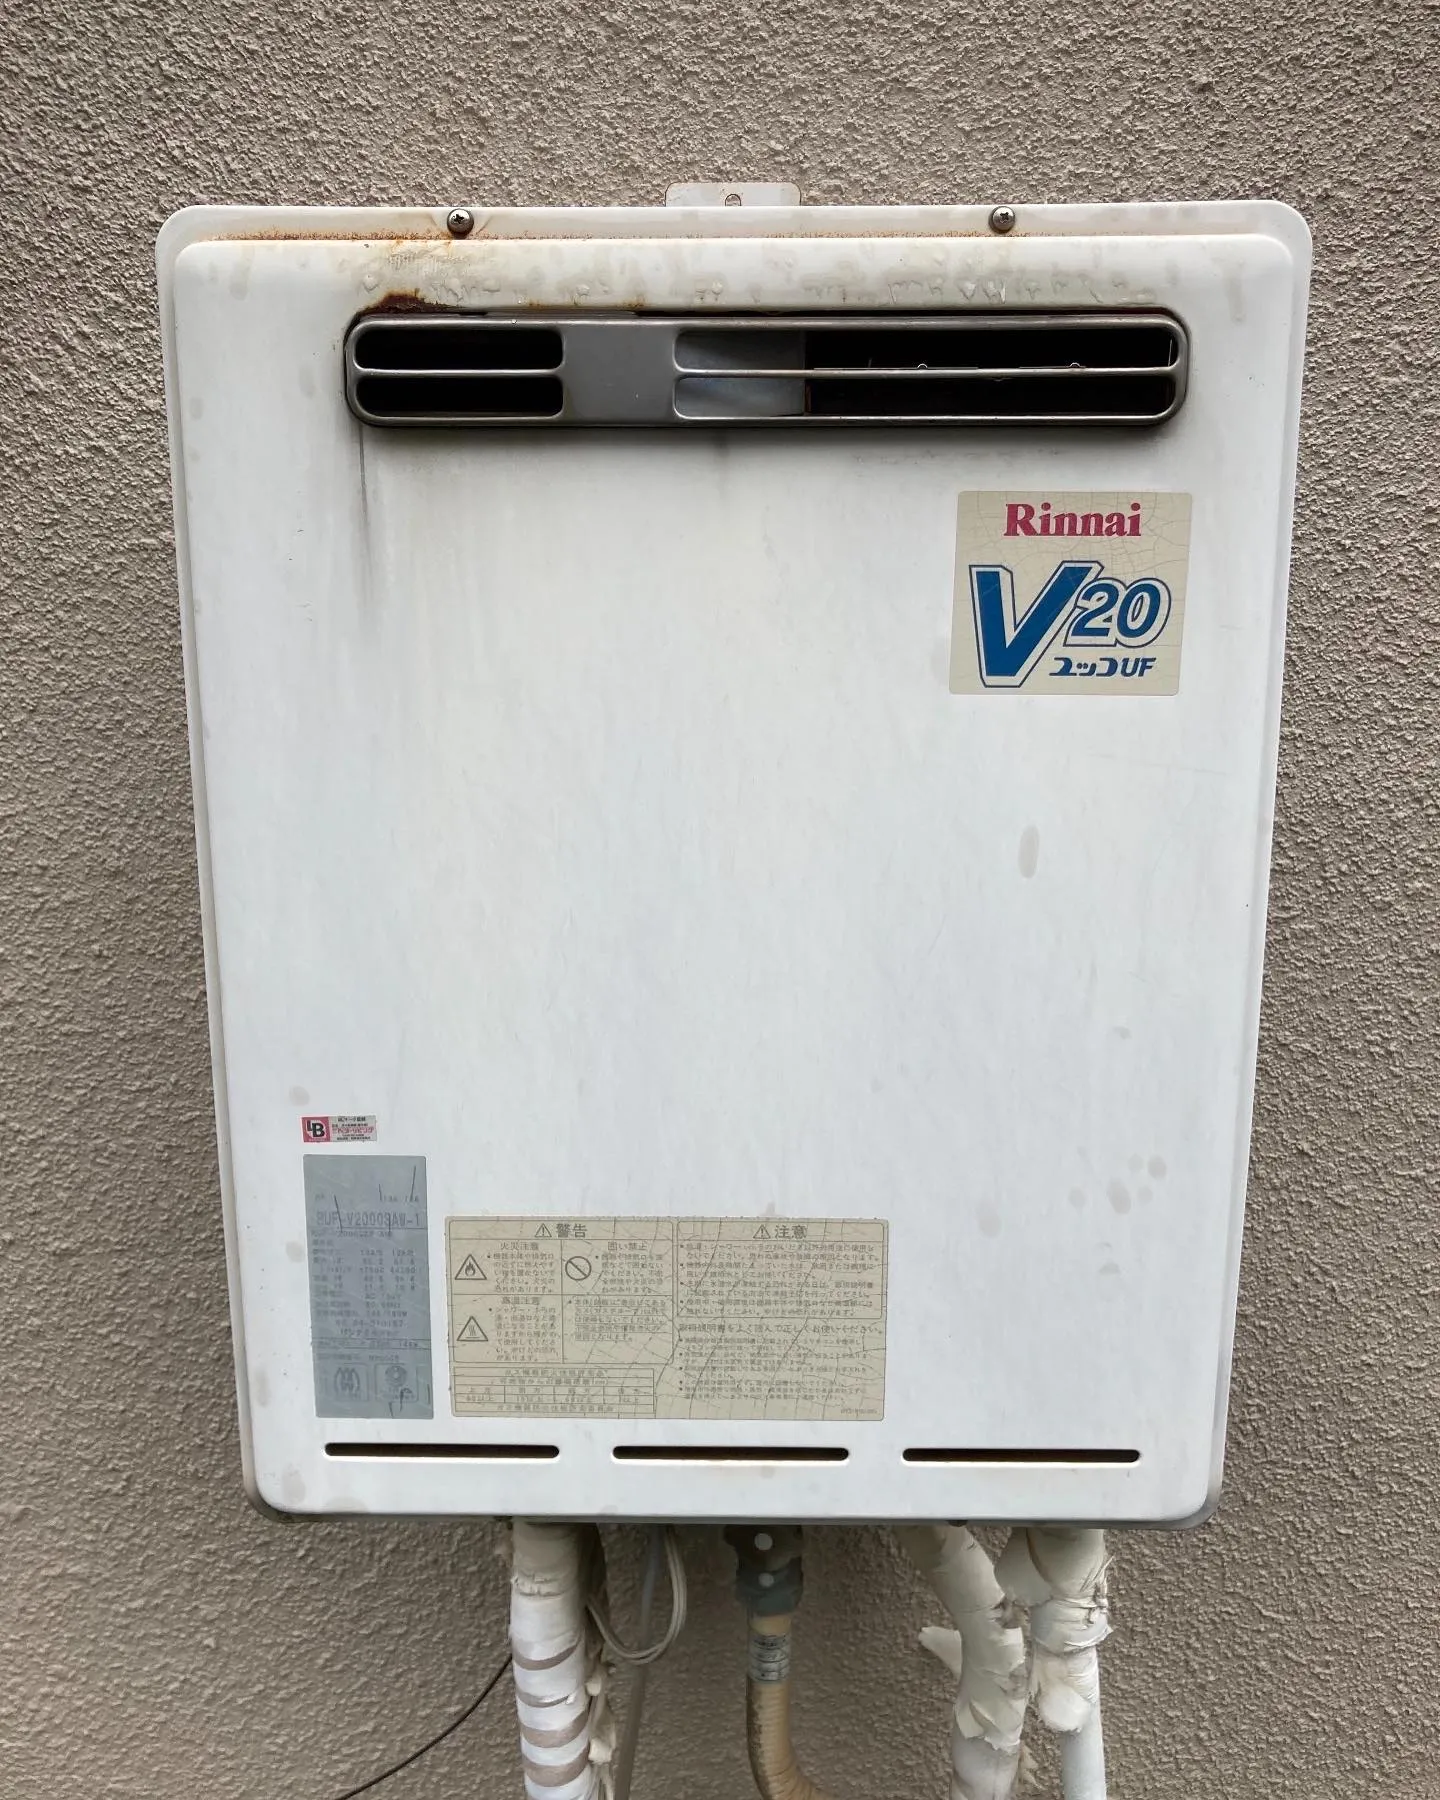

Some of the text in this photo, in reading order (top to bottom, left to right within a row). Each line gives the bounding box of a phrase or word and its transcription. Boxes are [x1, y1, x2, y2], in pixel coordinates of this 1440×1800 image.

[1003, 502, 1142, 537] Rinnai
[1049, 657, 1157, 677] ユッコUF
[556, 1223, 588, 1238] 警告
[774, 1224, 808, 1239] 注意
[500, 1241, 539, 1251] 火災注意
